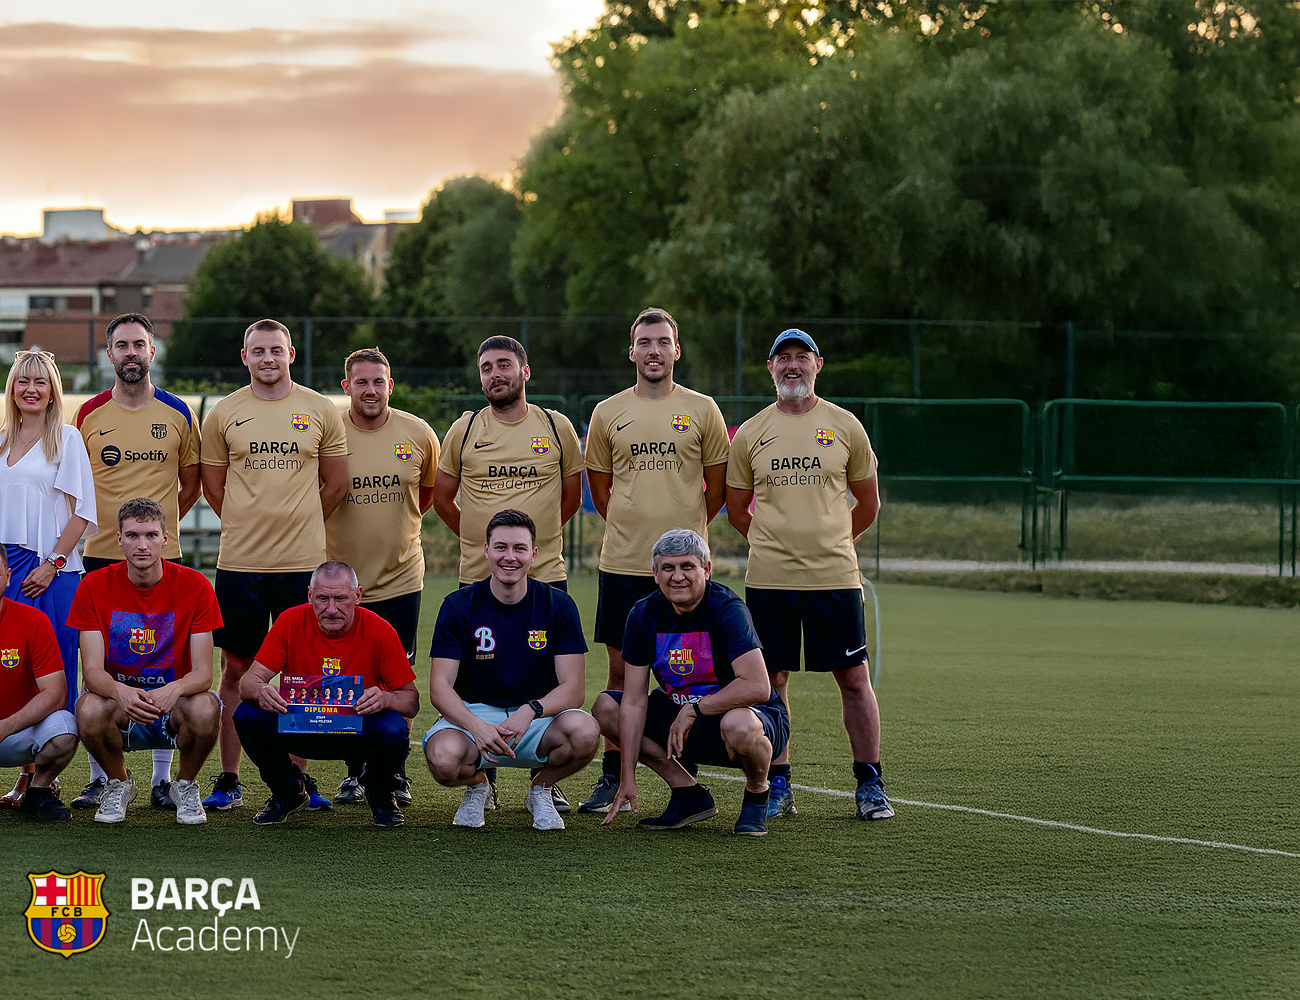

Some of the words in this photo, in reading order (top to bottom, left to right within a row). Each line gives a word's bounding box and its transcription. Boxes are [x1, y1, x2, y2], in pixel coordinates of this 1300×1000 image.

[124, 450, 168, 463] Spotify
[250, 442, 299, 456] BARÇA
[630, 442, 677, 457] BARÇA
[244, 456, 305, 472] Academy
[628, 457, 684, 473] Academy
[771, 456, 821, 472] BARÇA
[488, 466, 538, 479] BARÇA
[766, 471, 829, 489] Academy
[352, 474, 401, 489] BARÇA
[346, 490, 407, 505] Academy
